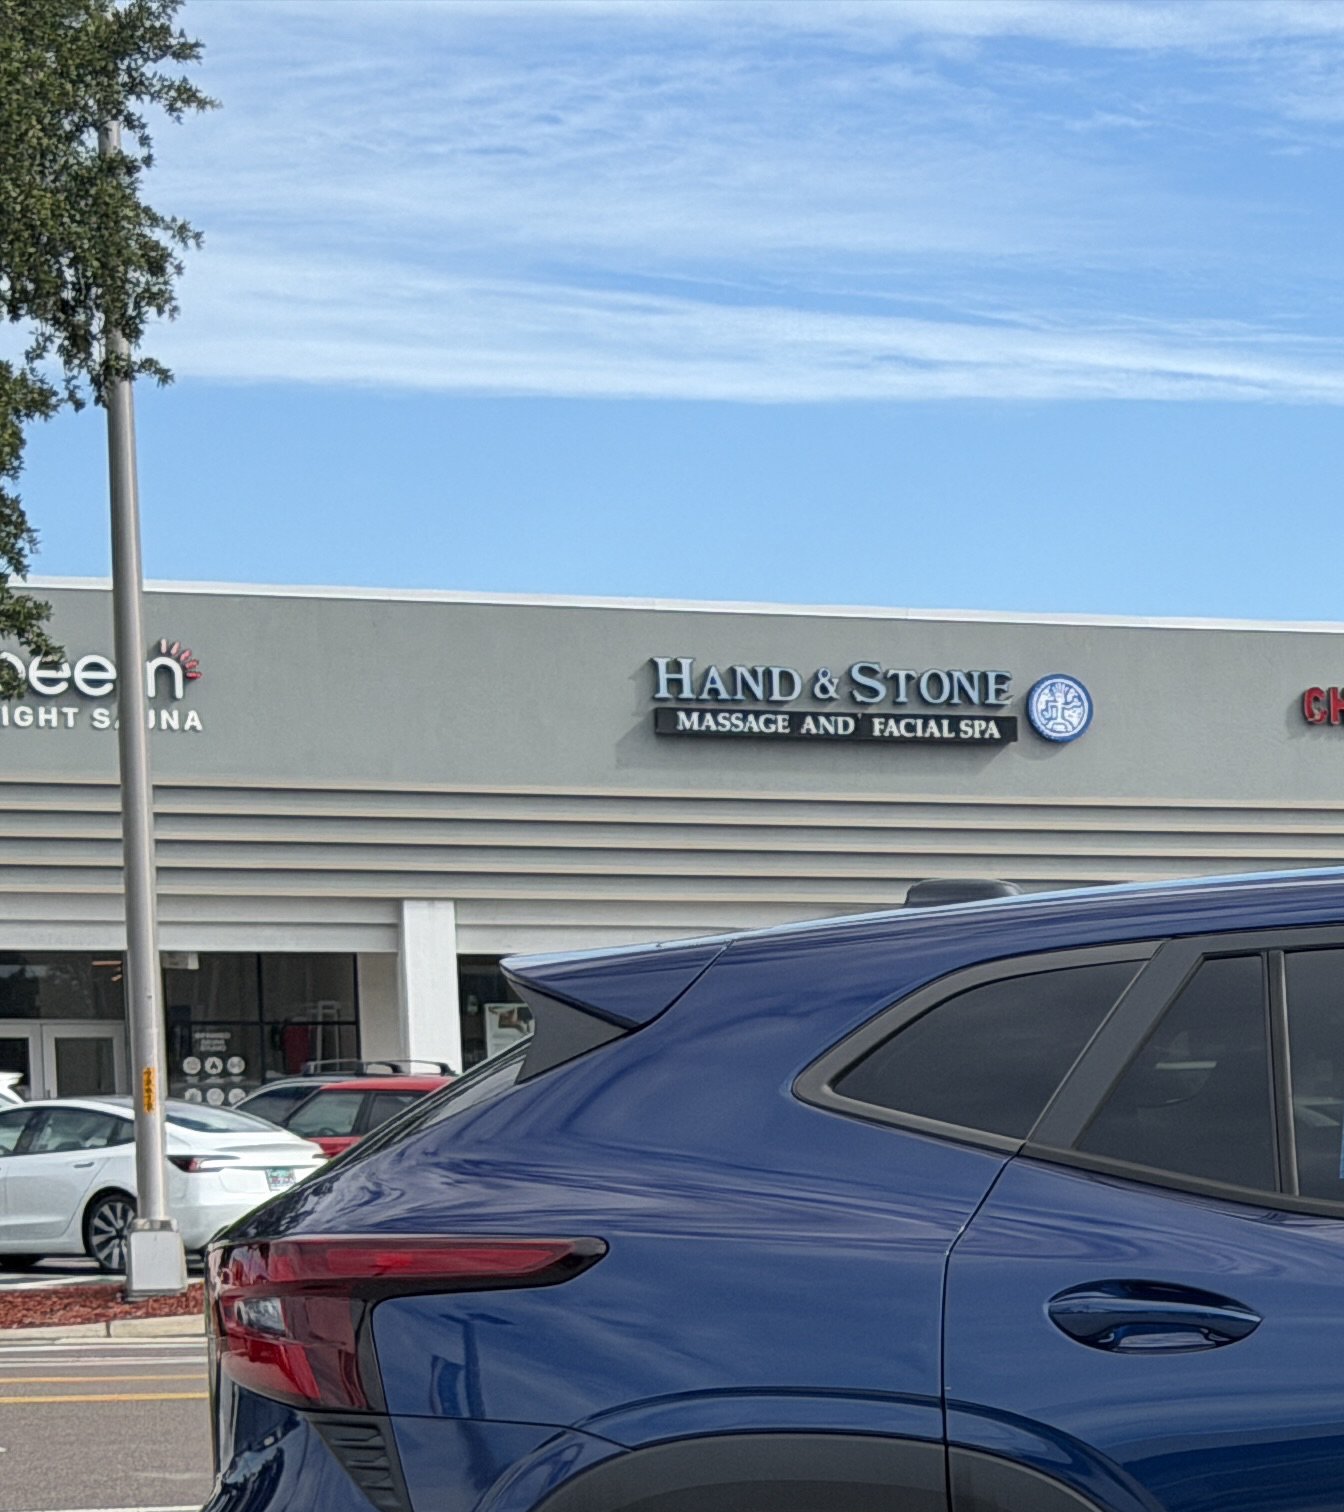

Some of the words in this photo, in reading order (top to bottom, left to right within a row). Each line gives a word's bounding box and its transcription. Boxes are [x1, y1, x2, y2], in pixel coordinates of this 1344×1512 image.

[653, 657, 802, 701] HAND
[813, 667, 840, 699] &
[849, 661, 1013, 705] STONE
[92, 707, 203, 731] SNA
[677, 710, 790, 734] MASSAGE
[800, 715, 855, 735] AND
[872, 717, 955, 738] FACIAL
[959, 720, 1001, 739] SPA
